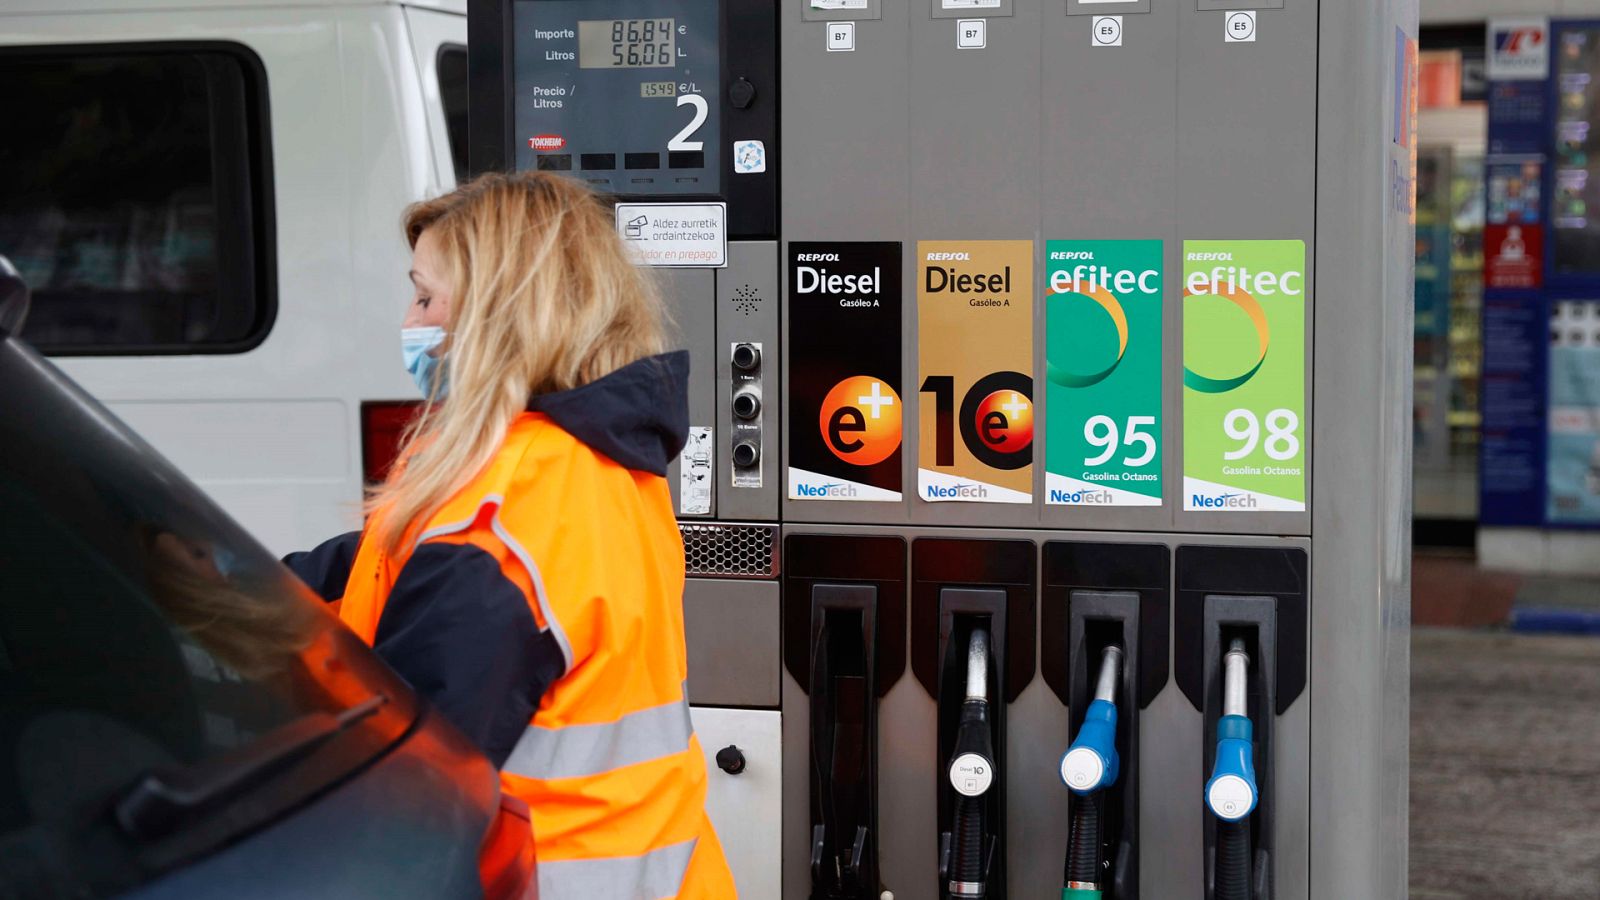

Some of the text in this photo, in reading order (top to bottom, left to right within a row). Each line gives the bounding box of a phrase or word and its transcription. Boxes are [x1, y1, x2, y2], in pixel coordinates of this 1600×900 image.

[677, 25, 687, 34] €
[1101, 27, 1113, 35] E5
[1235, 22, 1246, 31] E5
[535, 29, 575, 40] Importe
[612, 21, 671, 43] 86,84
[835, 33, 846, 41] B7
[966, 30, 977, 38] B7
[546, 51, 575, 60] Litros
[612, 43, 670, 66] 56,06
[678, 48, 687, 57] L.
[533, 85, 576, 96] Precio /
[645, 83, 674, 96] 1,549
[533, 99, 563, 109] Litros
[667, 94, 709, 151] 2
[529, 137, 562, 149] TOKHEIM
[653, 219, 718, 229] Aldez aurretik
[653, 231, 715, 241] ordaintzekoa
[665, 251, 676, 259] en
[678, 250, 718, 261] prepago
[797, 253, 840, 262] REPSOL
[927, 252, 970, 261] REPSOL
[1050, 251, 1094, 260] REPSOL
[1187, 252, 1233, 261] REPSOL
[796, 266, 881, 294] Diesel
[925, 265, 1011, 293] Diesel
[1050, 265, 1159, 294] efitec
[1186, 266, 1301, 296] efitec
[839, 299, 880, 308] Gasóleo A
[969, 298, 1010, 307] Gasóleo A
[1223, 408, 1300, 461] 98
[1083, 414, 1157, 467] 95
[1222, 466, 1301, 476] Gasolina Octanos
[1082, 472, 1158, 481] Gasolina Octanos
[797, 483, 857, 498] NeoTech
[927, 484, 988, 499] NeoTech
[1050, 488, 1113, 504] NeoTech
[1192, 493, 1257, 508] NeoTech
[973, 766, 984, 775] 10
